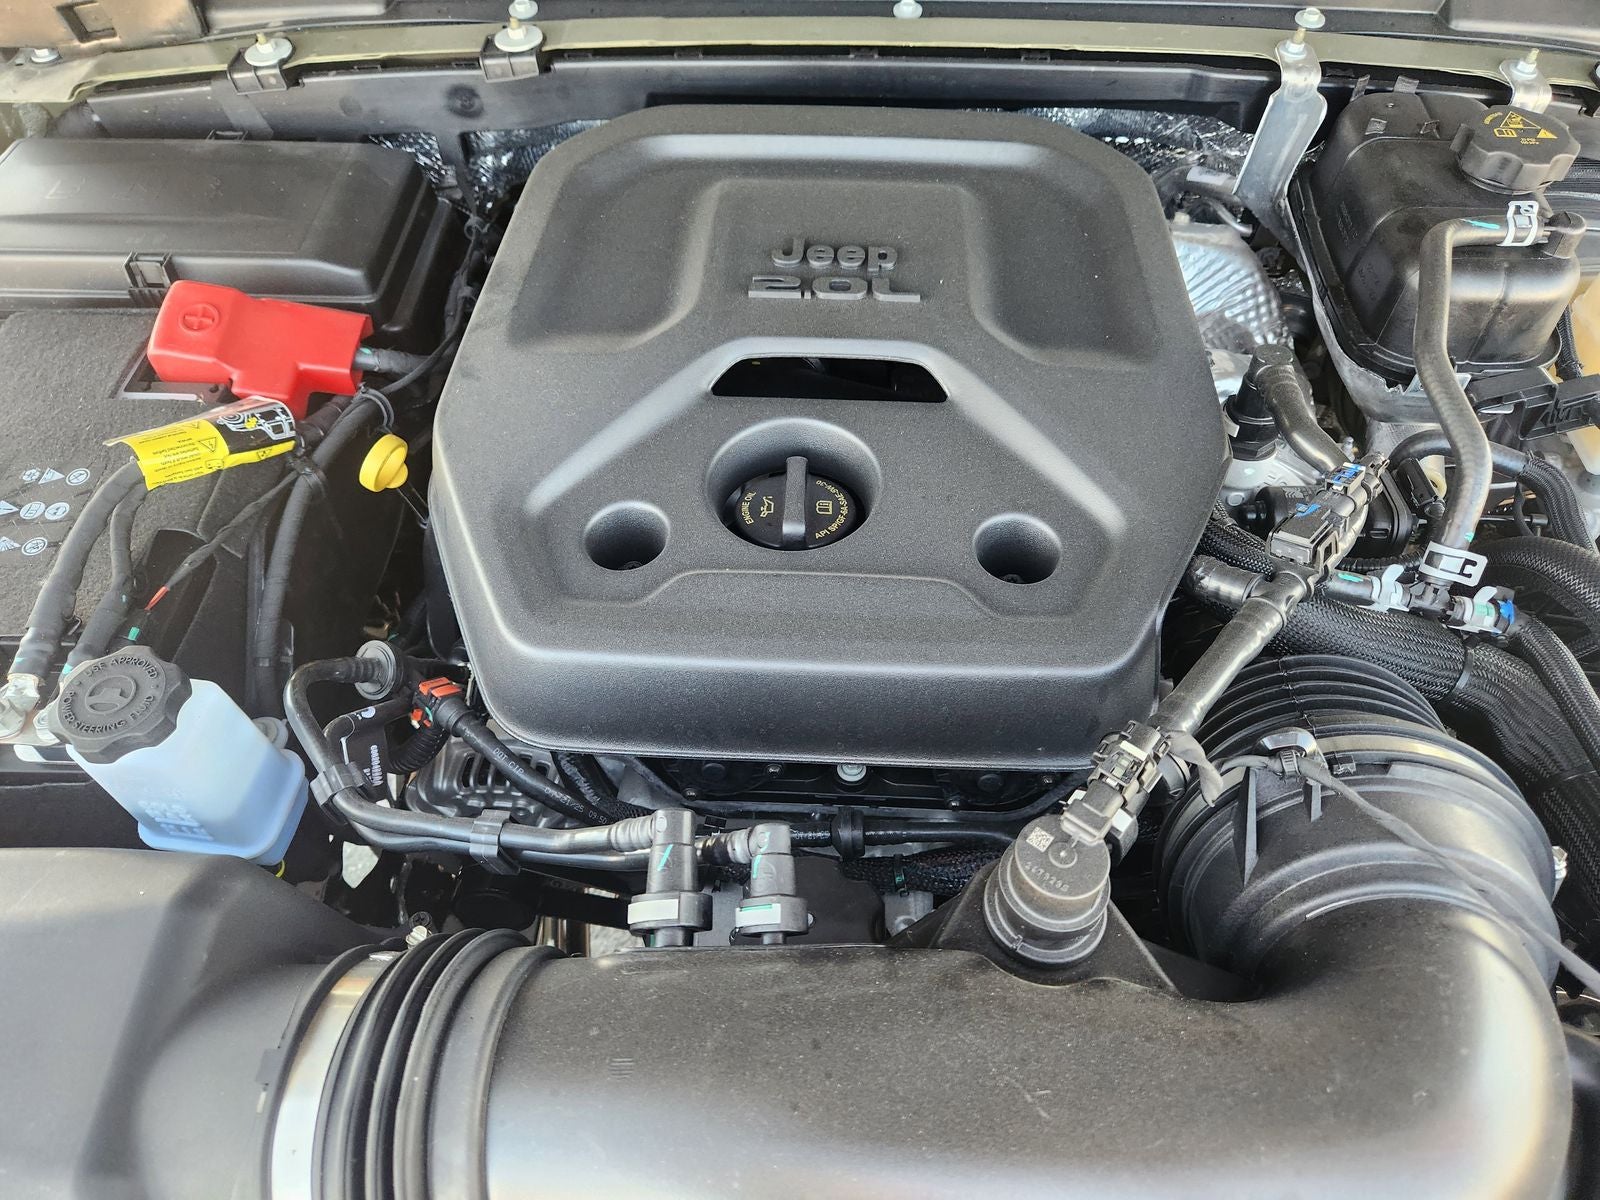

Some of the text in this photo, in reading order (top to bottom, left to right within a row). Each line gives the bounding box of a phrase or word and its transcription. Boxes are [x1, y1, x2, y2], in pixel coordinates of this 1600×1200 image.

[771, 238, 898, 278] Jeep
[748, 274, 921, 303] 2.0L
[741, 491, 757, 525] ENGINE OIL
[815, 529, 831, 539] API
[110, 656, 159, 680] APPROVED
[62, 689, 77, 725] POWER
[73, 719, 128, 734] STEERING
